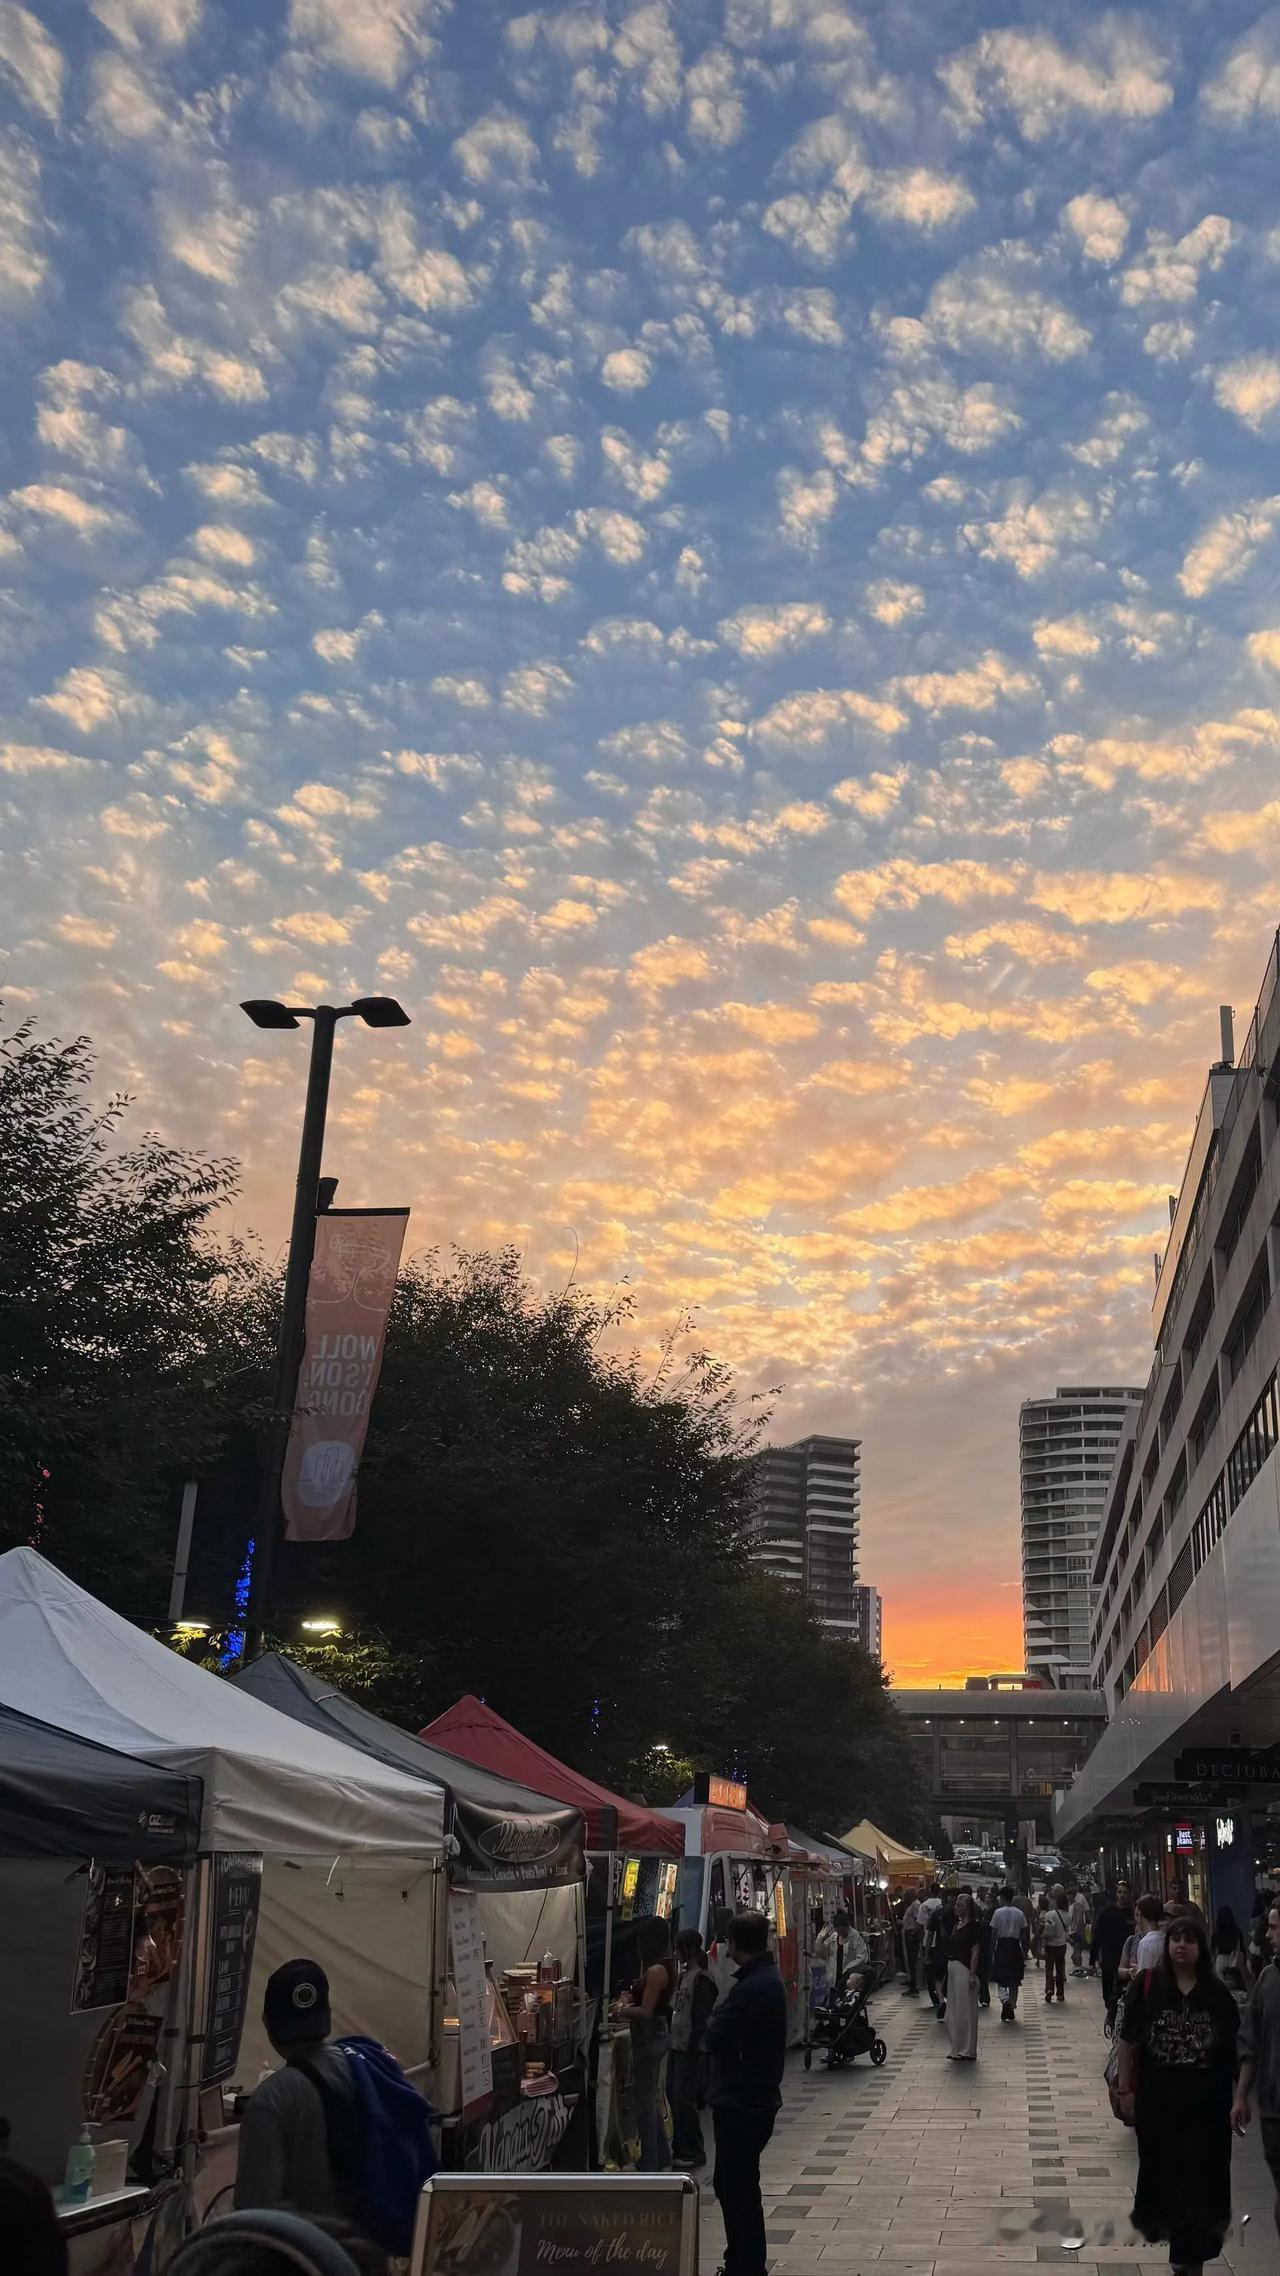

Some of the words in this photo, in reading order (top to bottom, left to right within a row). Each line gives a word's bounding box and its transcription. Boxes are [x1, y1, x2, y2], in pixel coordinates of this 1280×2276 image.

[536, 2239, 581, 2265] Menu
[584, 2239, 606, 2265] of
[606, 2231, 633, 2263] the
[635, 2239, 673, 2270] day
